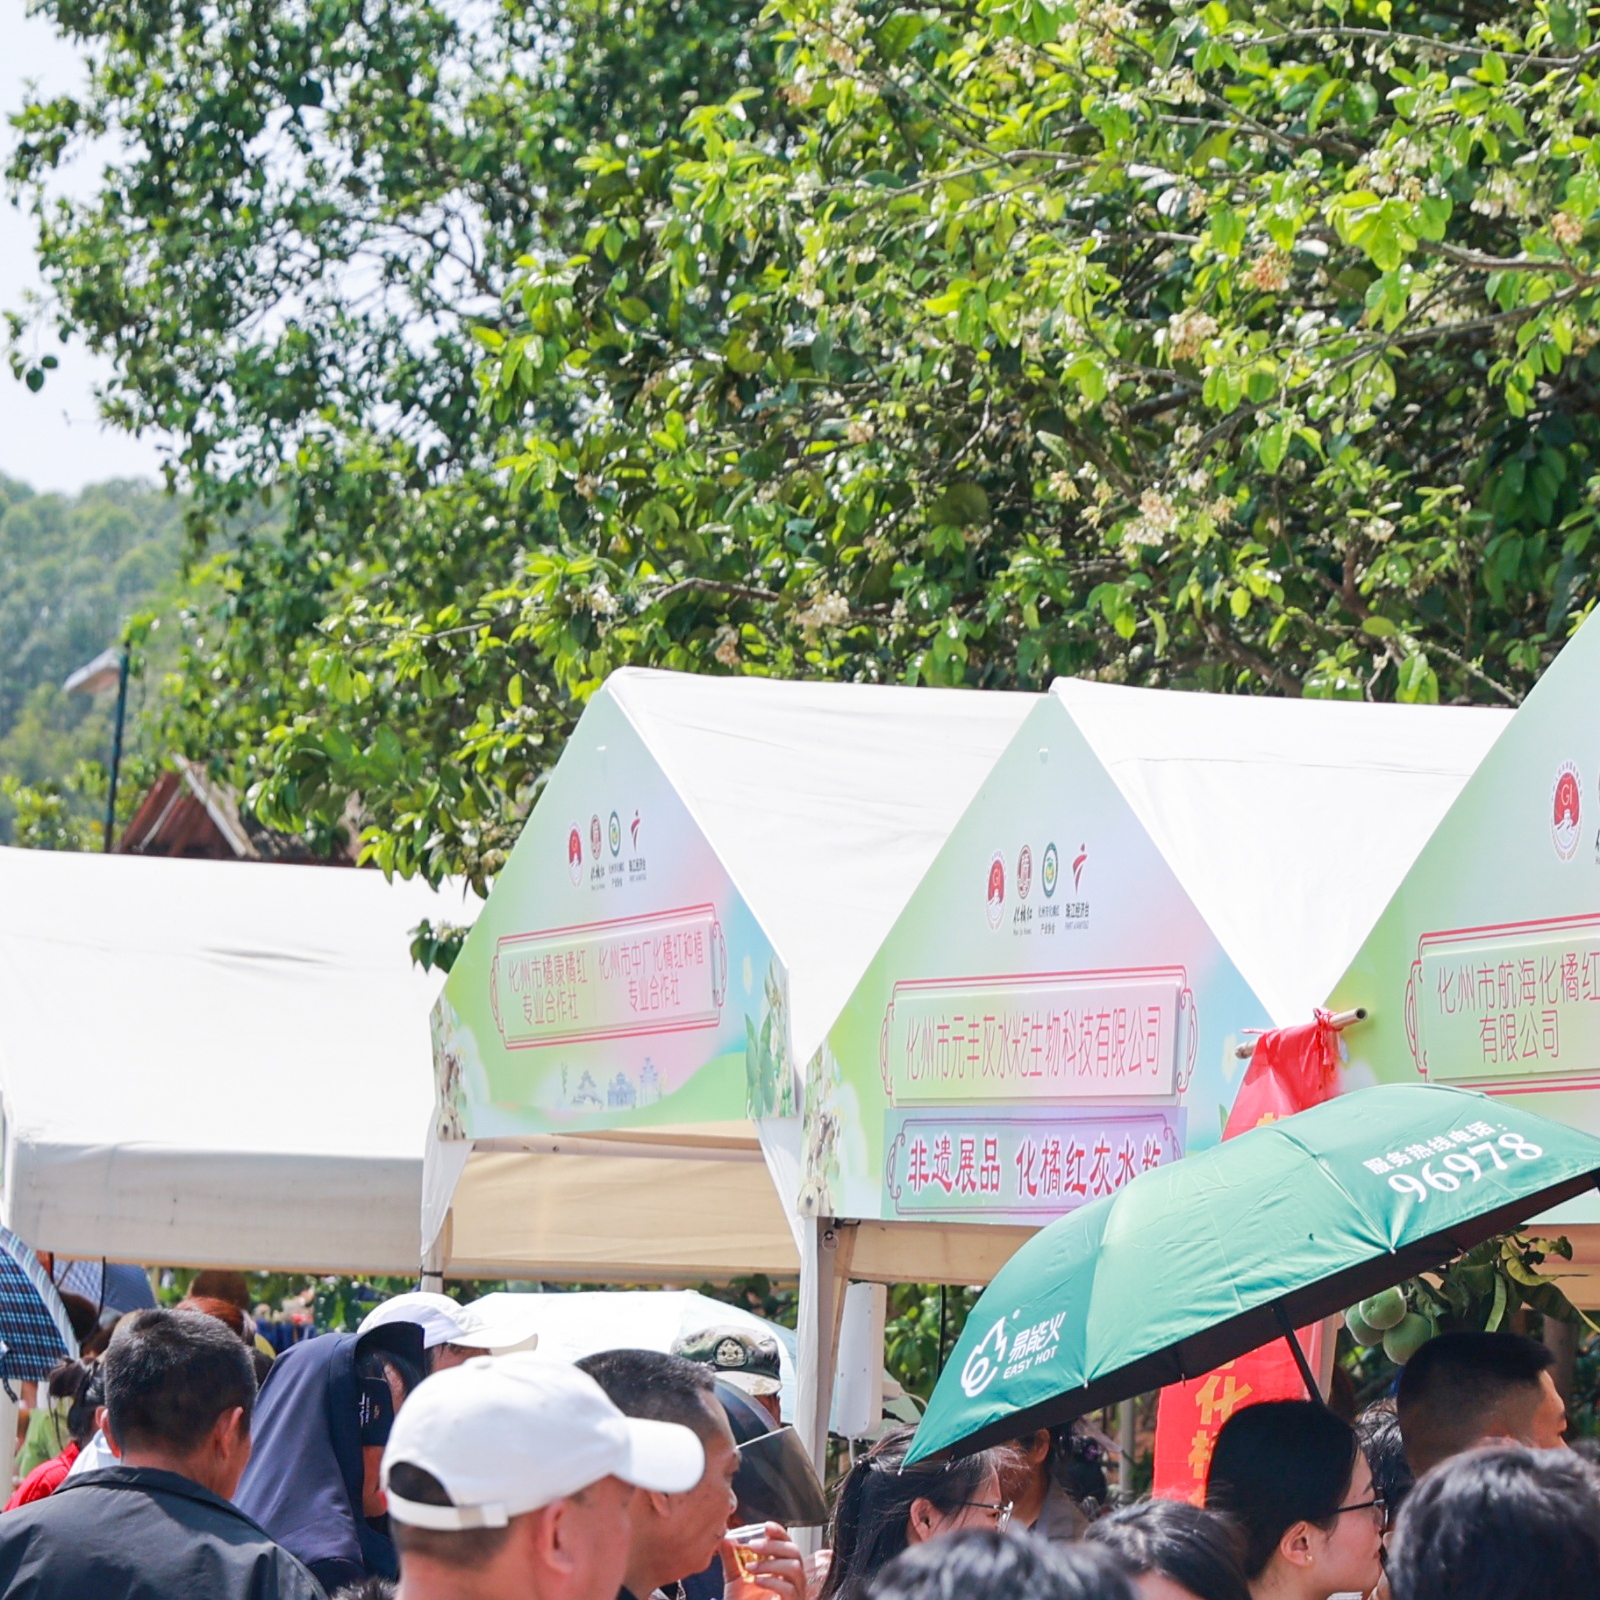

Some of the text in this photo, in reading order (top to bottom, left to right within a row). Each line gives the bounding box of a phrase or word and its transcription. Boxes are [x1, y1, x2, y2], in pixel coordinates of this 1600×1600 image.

[522, 986, 579, 1026] 专业合作社
[628, 972, 681, 1012] 专业合作社
[1479, 1009, 1560, 1064] 有限公司
[907, 1135, 1001, 1193] 非遗展品
[1387, 1132, 1543, 1203] 96978
[1003, 1345, 1058, 1379] EASY HOT
